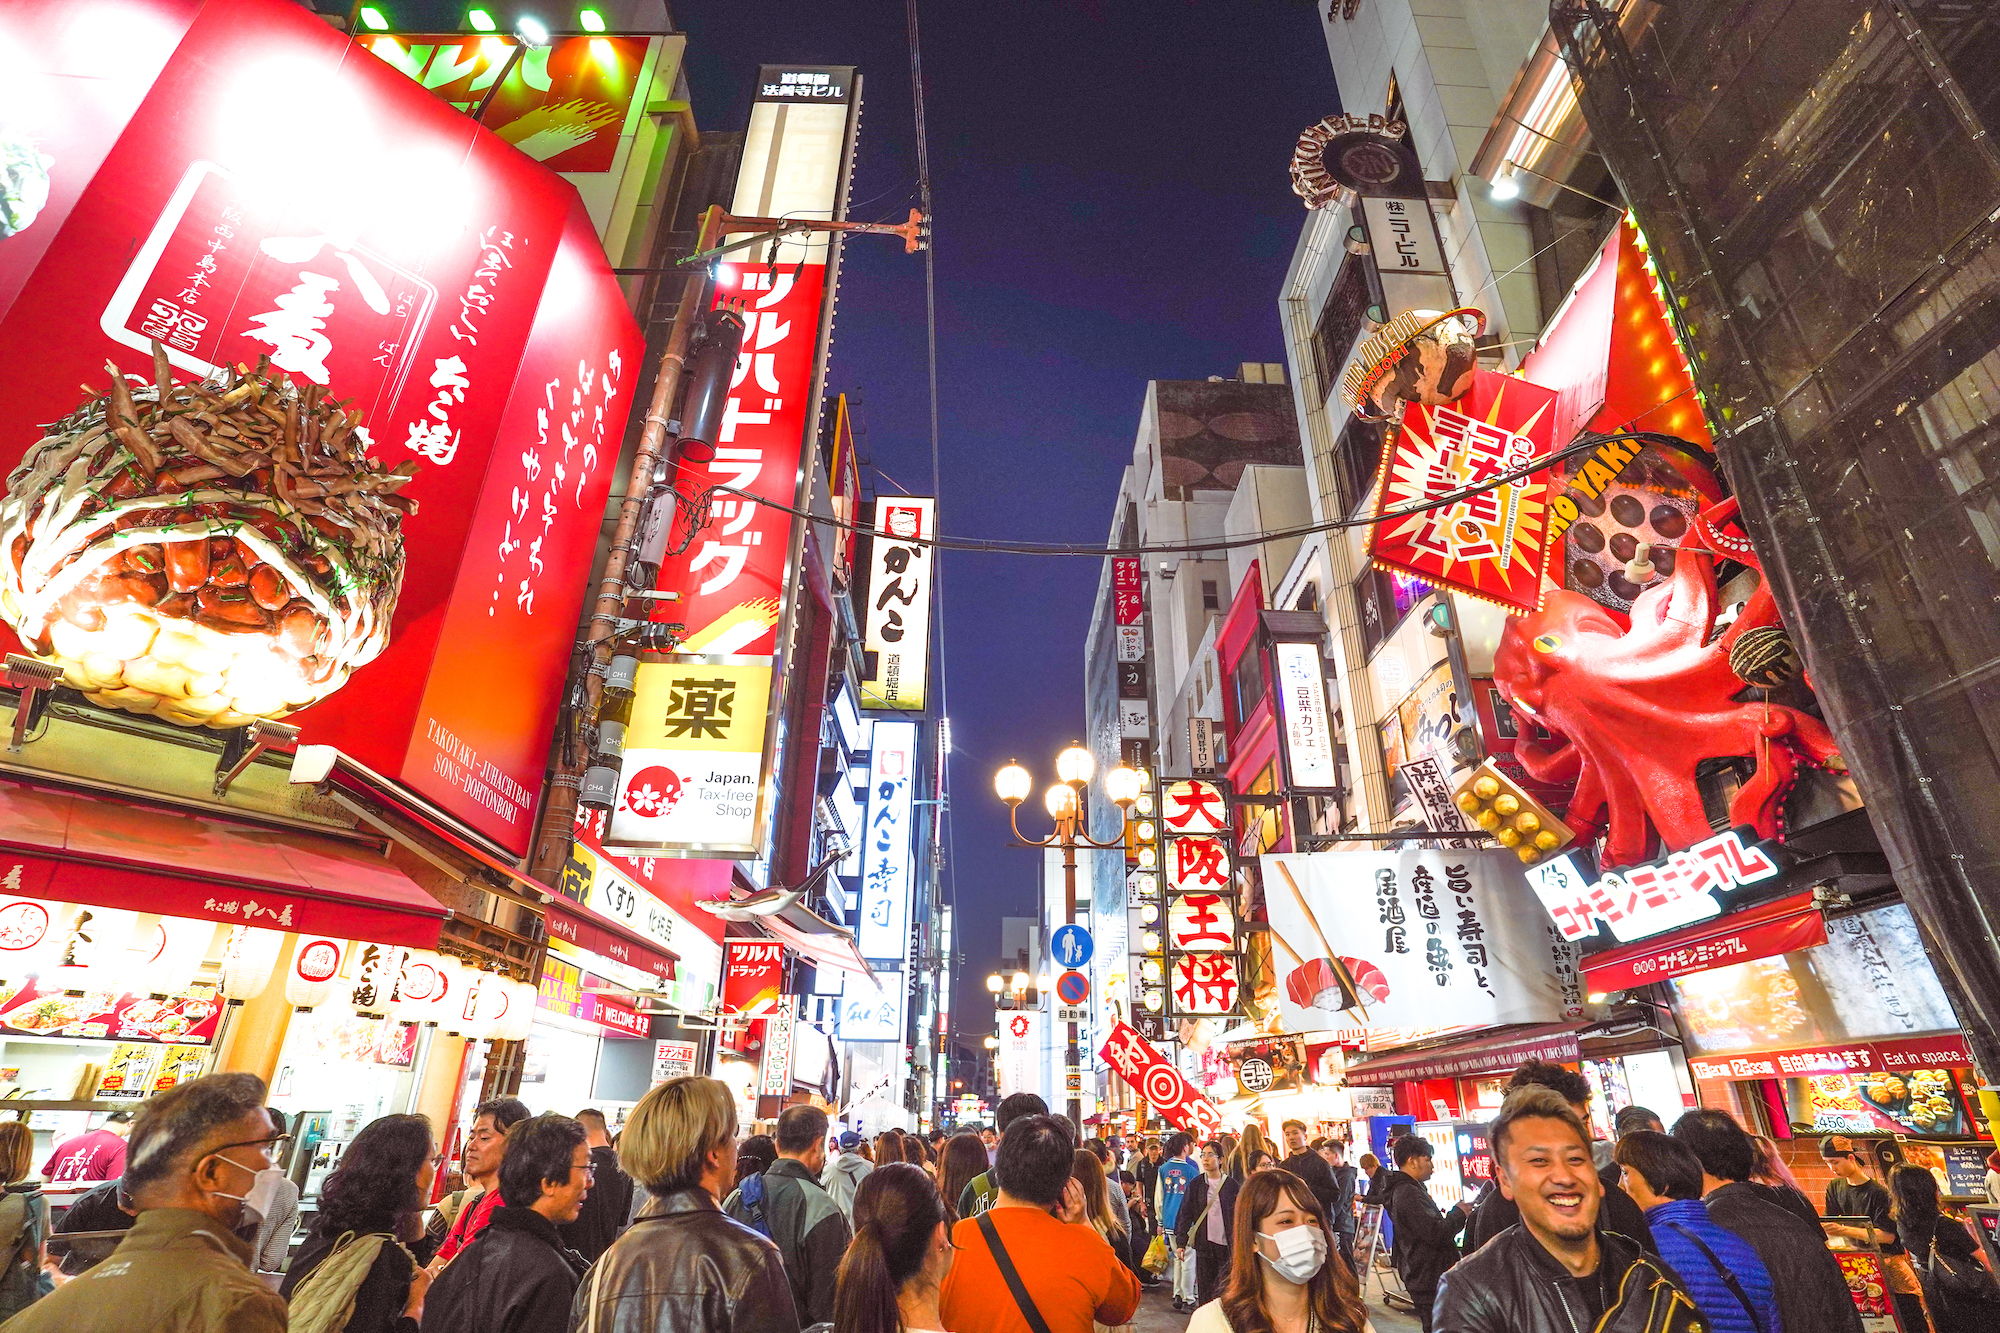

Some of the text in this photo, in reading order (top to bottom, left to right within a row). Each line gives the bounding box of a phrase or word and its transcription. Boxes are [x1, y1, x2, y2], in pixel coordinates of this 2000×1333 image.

[361, 44, 553, 92] ルハ
[762, 85, 844, 97] 法善寺ビル
[1359, 310, 1421, 369] MUSEUM
[1356, 345, 1410, 415] DOTONBORI
[690, 272, 797, 597] ツルハドラッグ
[1116, 561, 1128, 625] ダイニングバー
[1128, 561, 1139, 604] ダーツ &
[612, 671, 628, 680] CH1
[884, 653, 901, 701] 道頓堀店
[664, 677, 737, 740] 薬
[1312, 682, 1328, 760] MAMESHIBA CAFE
[605, 737, 622, 747] CH3
[426, 717, 533, 811] TAKOYAKI-JUHACHIBAN
[705, 771, 755, 788] Japan.
[433, 752, 519, 826] SONS-DOHTONBORI
[587, 783, 604, 793] CH4
[698, 788, 755, 802] Tax-free
[715, 804, 753, 820] Shop
[606, 879, 635, 919] くすり
[1163, 780, 1238, 1012] 大阪王将
[1551, 838, 1771, 937] コナモンミュージアム
[648, 906, 673, 942] 化粧品
[1374, 868, 1411, 954] 居酒屋
[1411, 864, 1454, 987] 産直の魚の
[730, 965, 771, 977] ドラッグ
[732, 945, 782, 962] ツルハ
[908, 928, 919, 997] TSUTAYA
[1658, 938, 1748, 971] コナモンミュージアム
[352, 944, 381, 1008] たこ焼
[547, 999, 571, 1015] STORE
[605, 1007, 635, 1029] WELCOME
[846, 1001, 897, 1028] 和食
[1059, 1010, 1088, 1019] 自動車
[658, 1048, 694, 1060] テナント募集
[1229, 1040, 1263, 1048] MAMESHIBA
[1281, 1035, 1304, 1043] OSAKA
[1777, 1048, 1872, 1074] 自由席あります
[1884, 1053, 1909, 1067] Eat
[1910, 1050, 1921, 1065] in
[1923, 1047, 1967, 1065] space.
[1462, 1155, 1492, 1178] 食べ放題
